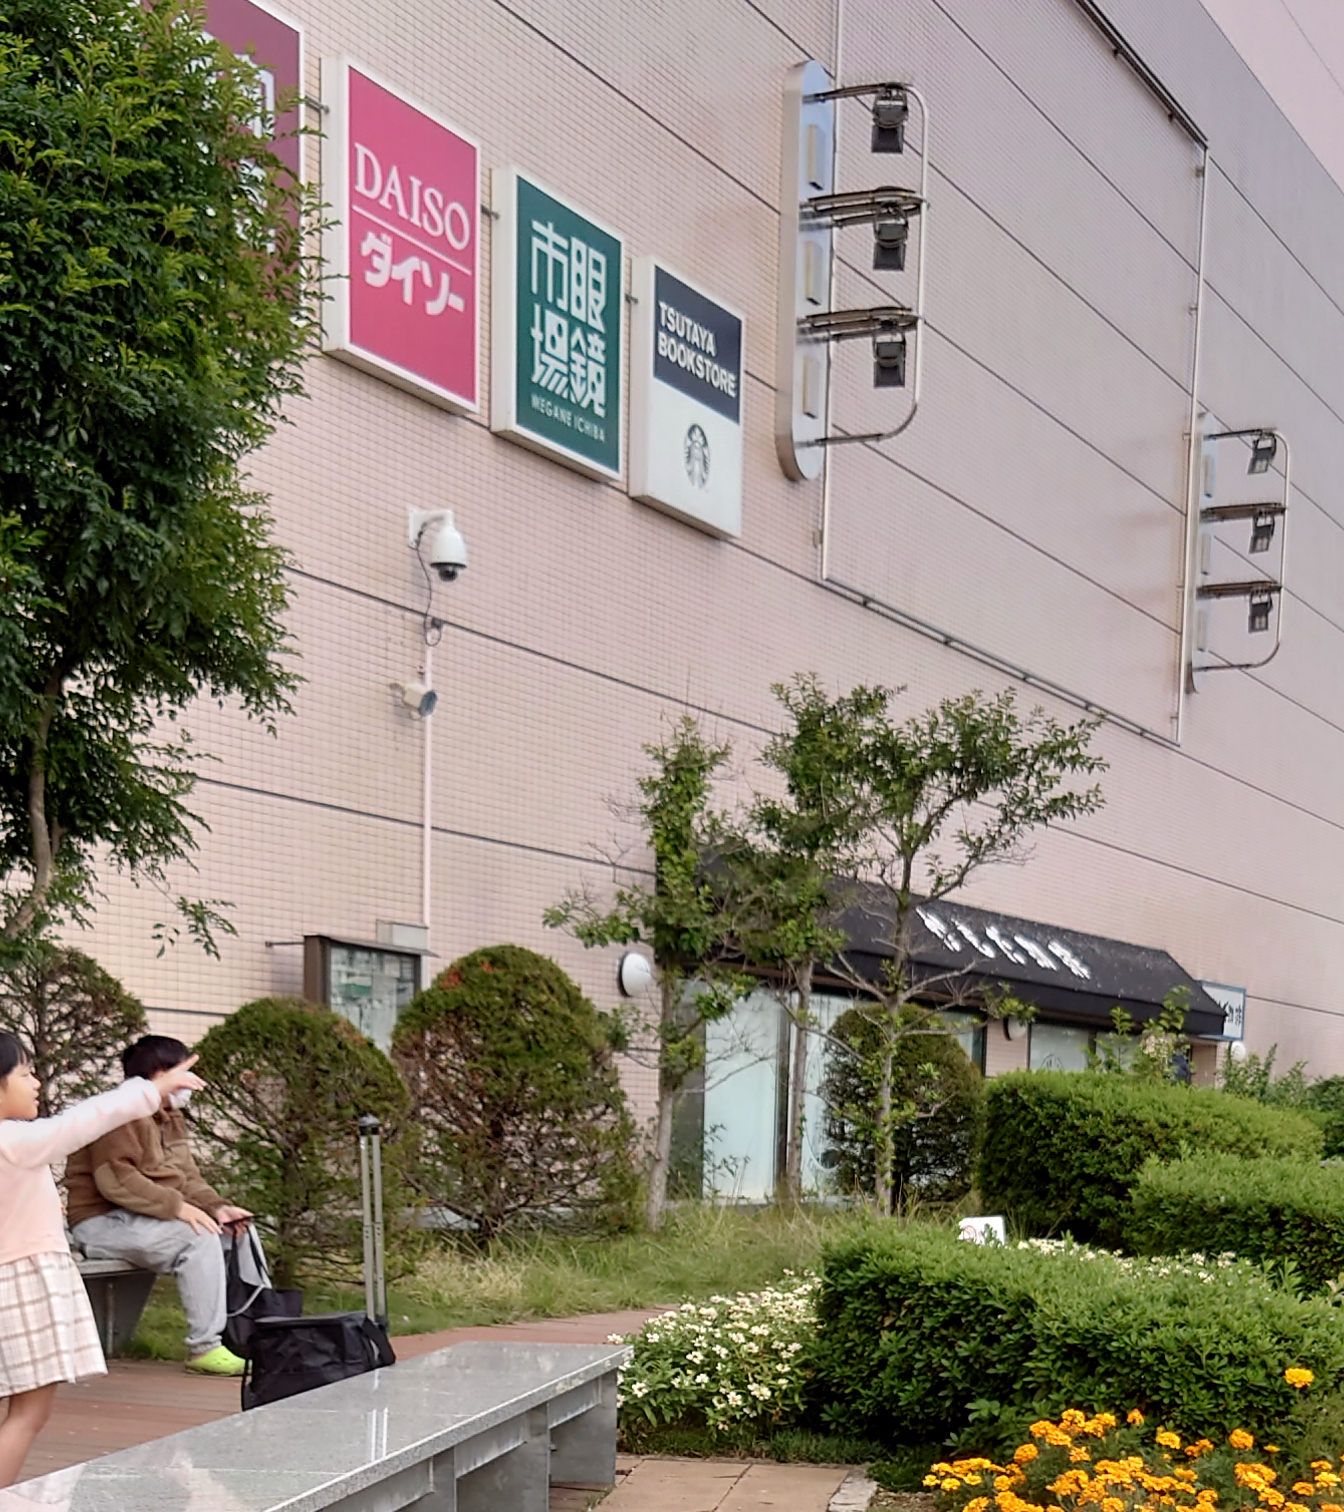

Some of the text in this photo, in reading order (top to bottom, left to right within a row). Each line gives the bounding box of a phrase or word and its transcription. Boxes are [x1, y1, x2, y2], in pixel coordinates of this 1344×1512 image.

[354, 142, 470, 250] DAISO
[360, 231, 465, 315] ダイソー
[658, 301, 716, 357] TSUTAYA
[658, 331, 736, 398] BOOKSTORE
[531, 394, 605, 442] MEGANE ICHIBA
